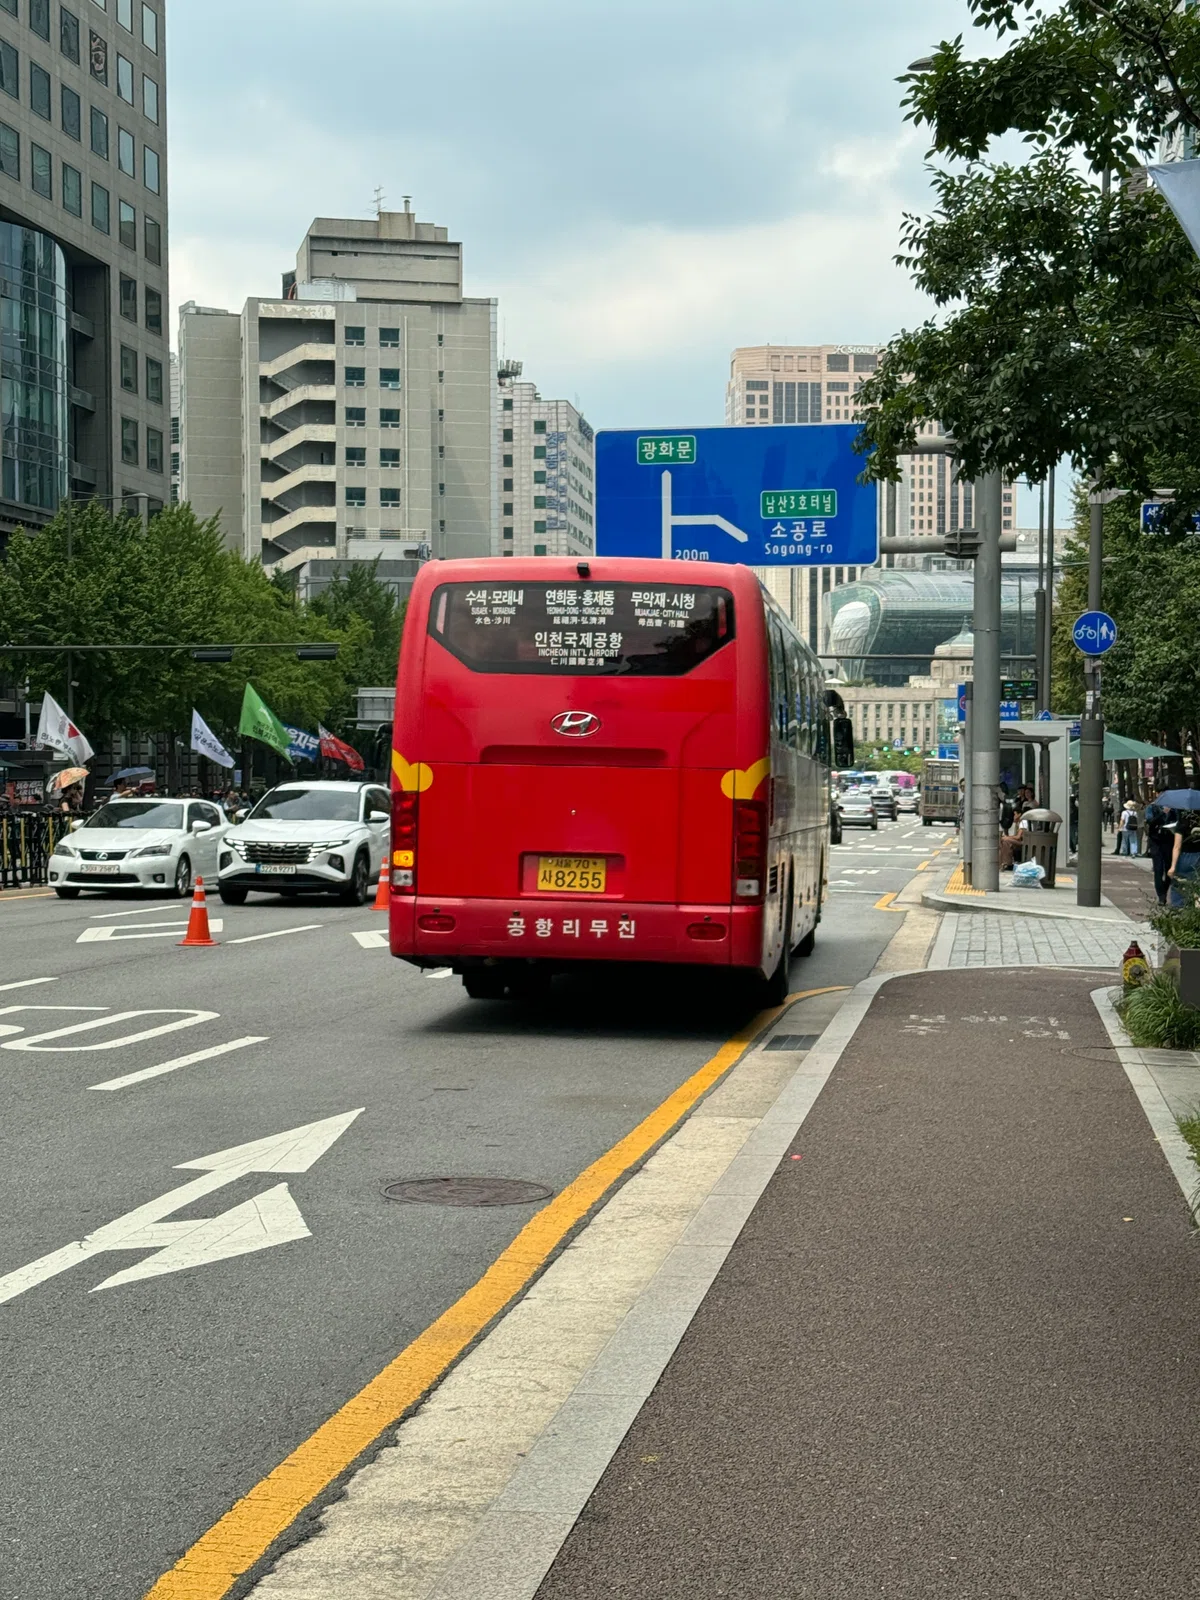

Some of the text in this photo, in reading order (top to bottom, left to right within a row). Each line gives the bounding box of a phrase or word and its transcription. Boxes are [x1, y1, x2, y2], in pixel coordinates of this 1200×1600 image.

[641, 441, 692, 460] 광화문
[766, 494, 831, 513] 남산3호터널
[770, 521, 827, 541] 소공로
[675, 550, 709, 561] 200m
[765, 543, 833, 557] Sogong-ro
[675, 610, 689, 619] HALL
[534, 632, 623, 648] 인천국제공항
[538, 648, 569, 656] INCHEON
[588, 649, 619, 657] AIRPORT
[554, 859, 590, 868] 서울 70
[507, 917, 636, 939] 공항리무진
